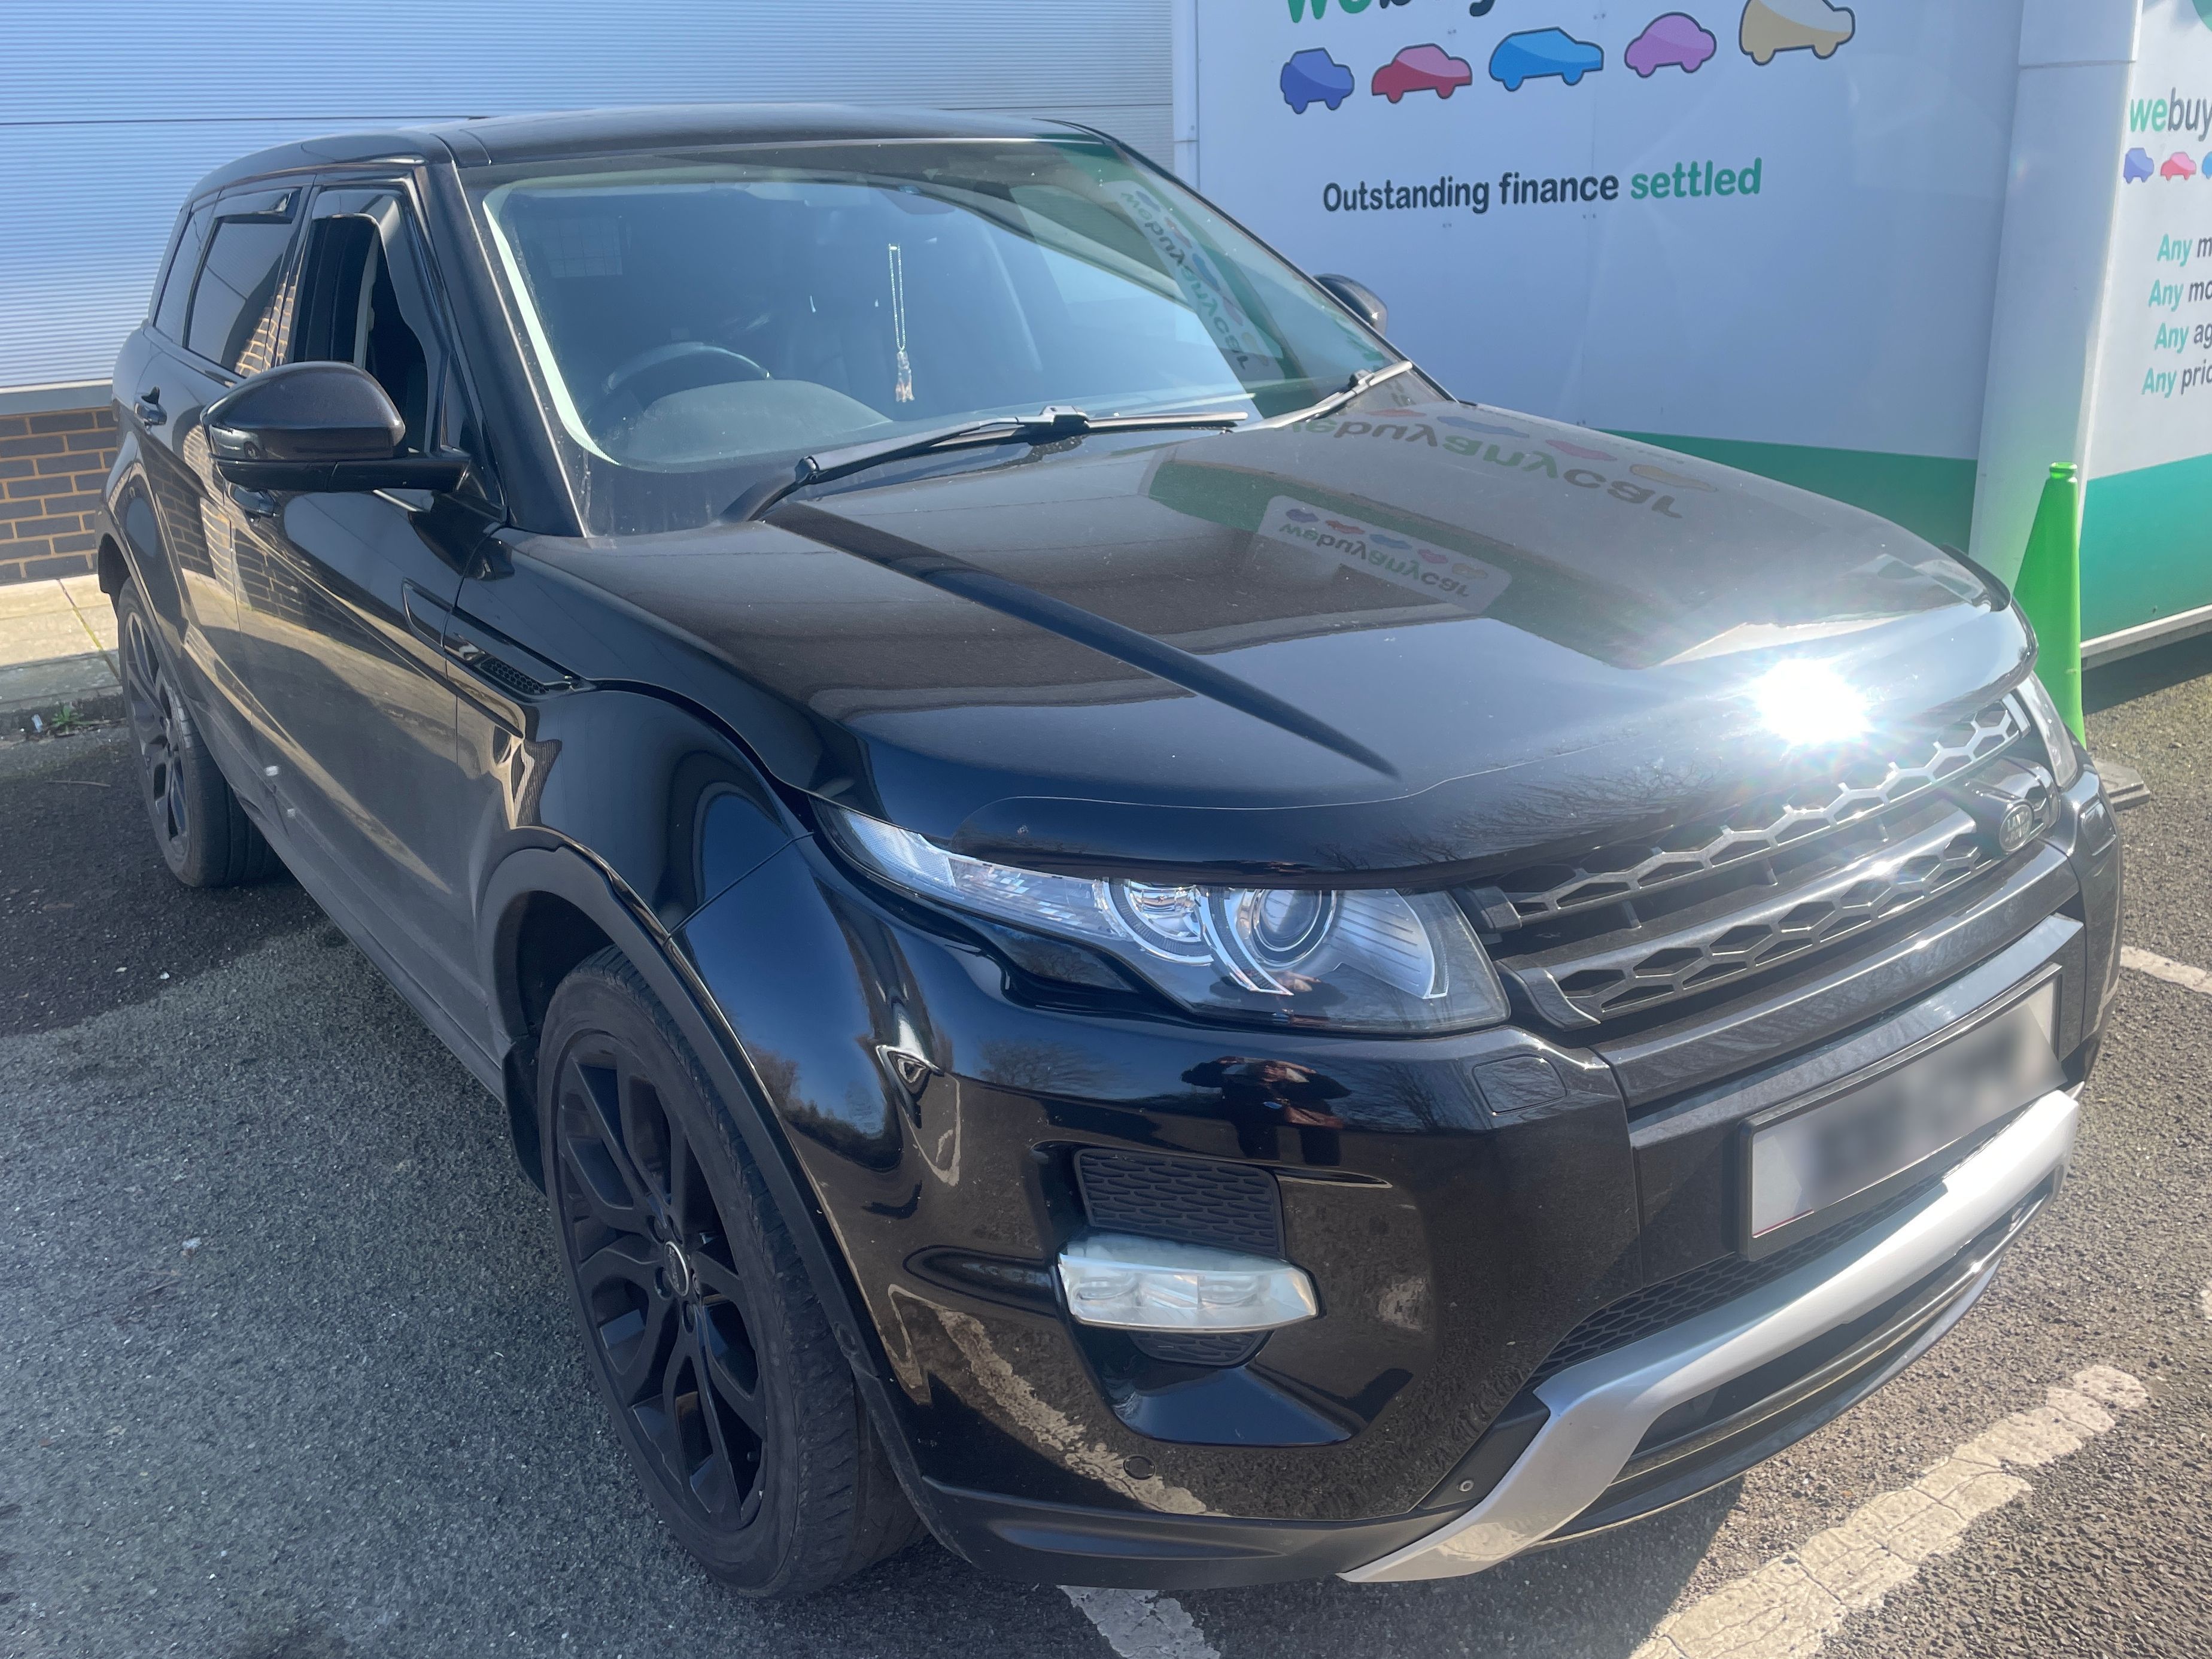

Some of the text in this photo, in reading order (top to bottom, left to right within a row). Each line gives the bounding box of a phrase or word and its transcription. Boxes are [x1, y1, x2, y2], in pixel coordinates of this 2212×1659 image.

[1323, 157, 1762, 214] Outstanding finance settled
[2157, 233, 2193, 267] Any
[2148, 278, 2184, 312] Any
[2154, 322, 2189, 354] Any
[2141, 367, 2177, 399] Any
